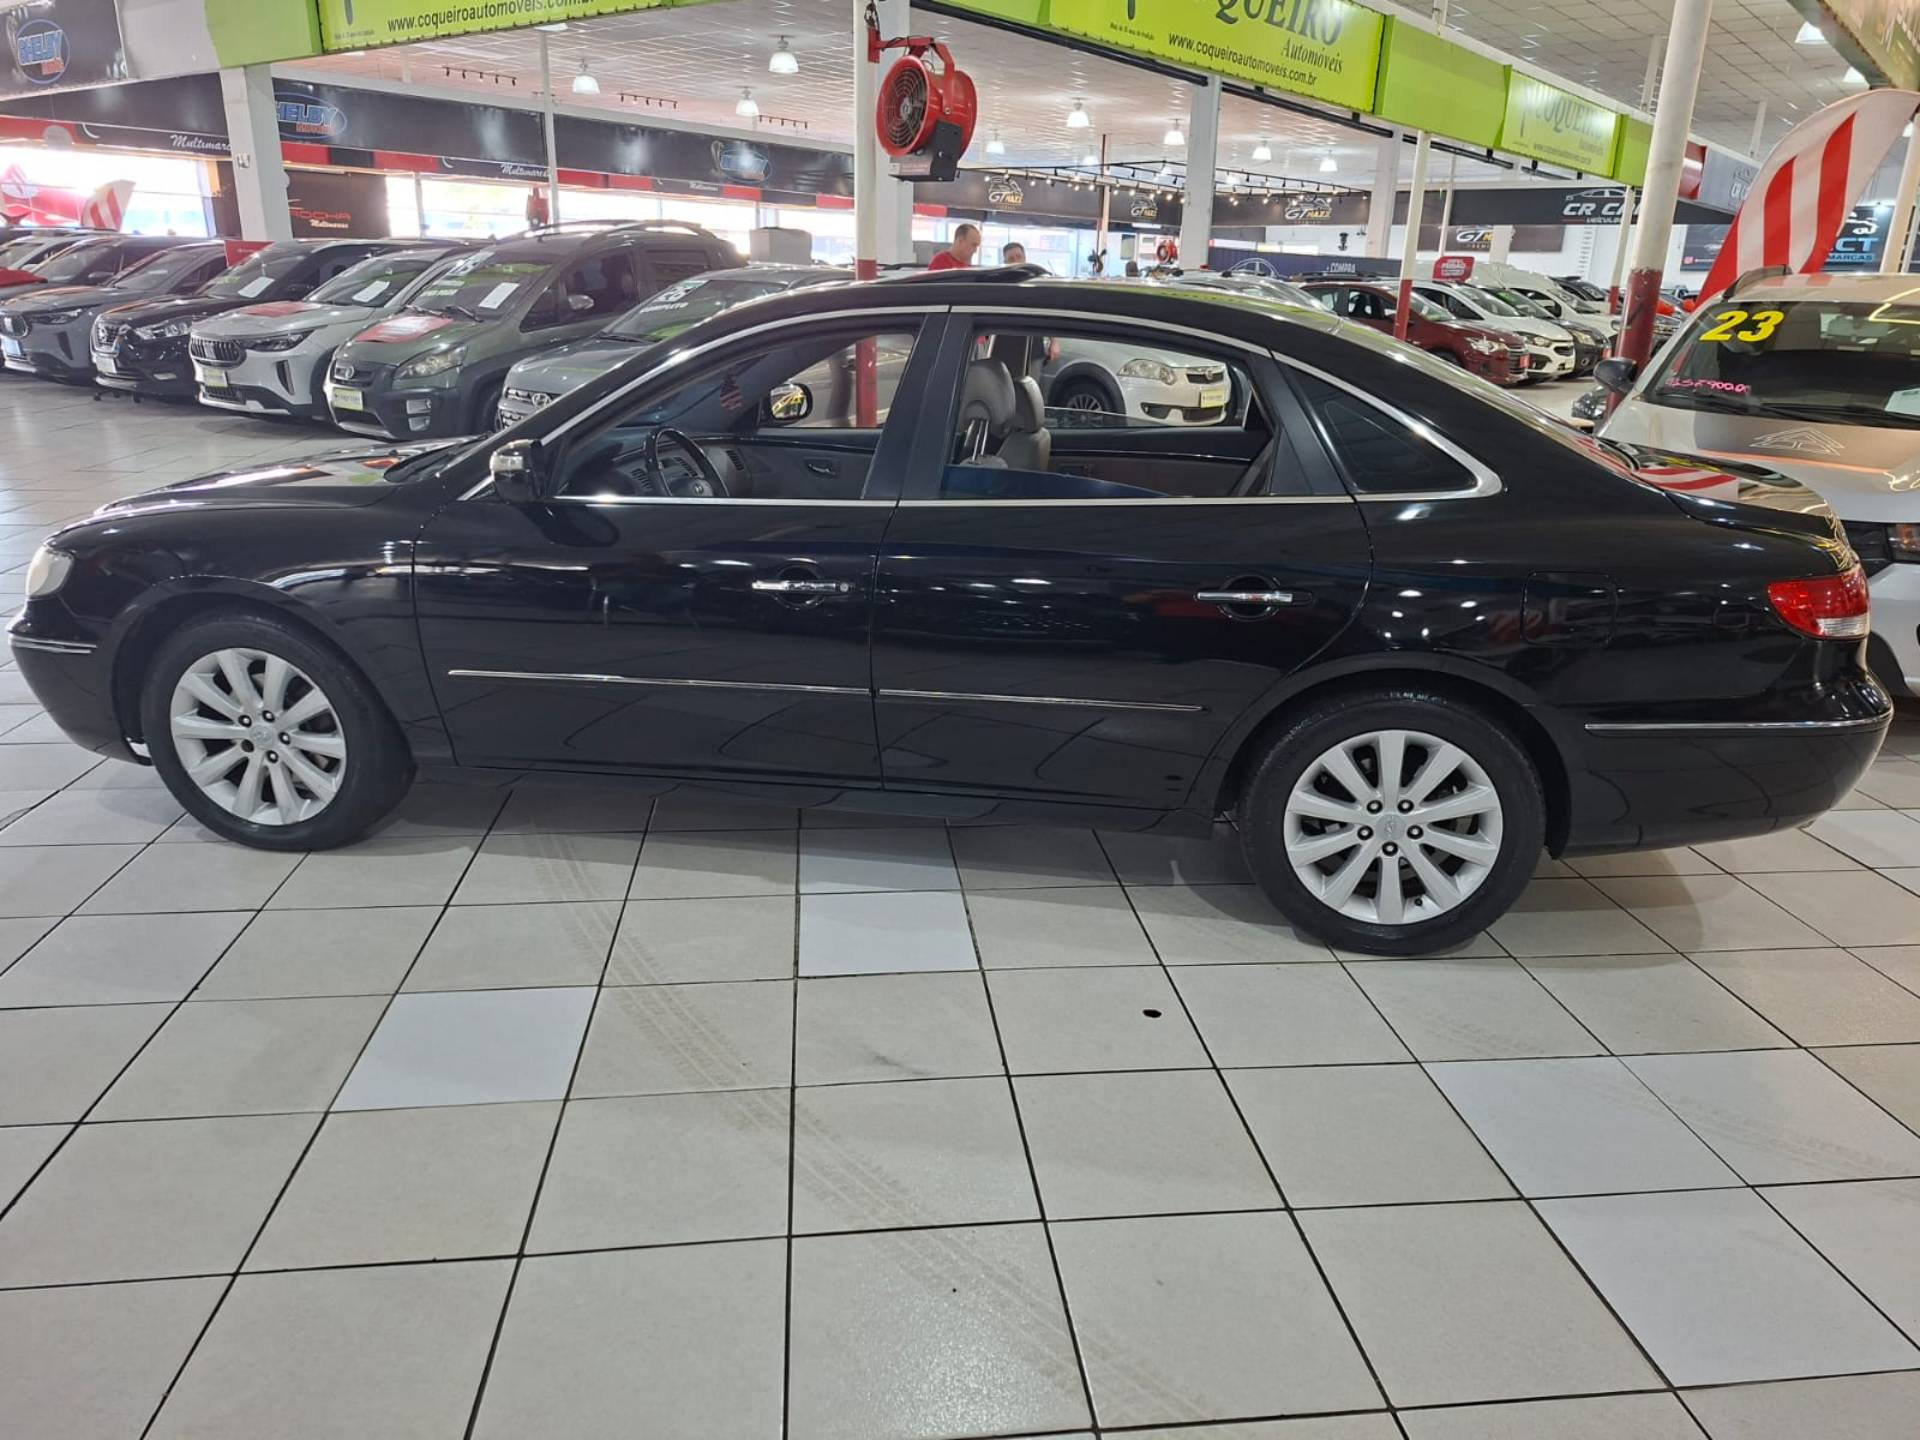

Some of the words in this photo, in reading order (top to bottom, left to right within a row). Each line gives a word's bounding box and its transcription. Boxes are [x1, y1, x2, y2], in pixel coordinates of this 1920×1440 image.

[1168, 32, 1318, 86] www.coqueiroautomoveis.com.br
[1281, 37, 1343, 74] Automóveis
[1563, 203, 1596, 216] CR
[1700, 311, 1785, 342] 23
